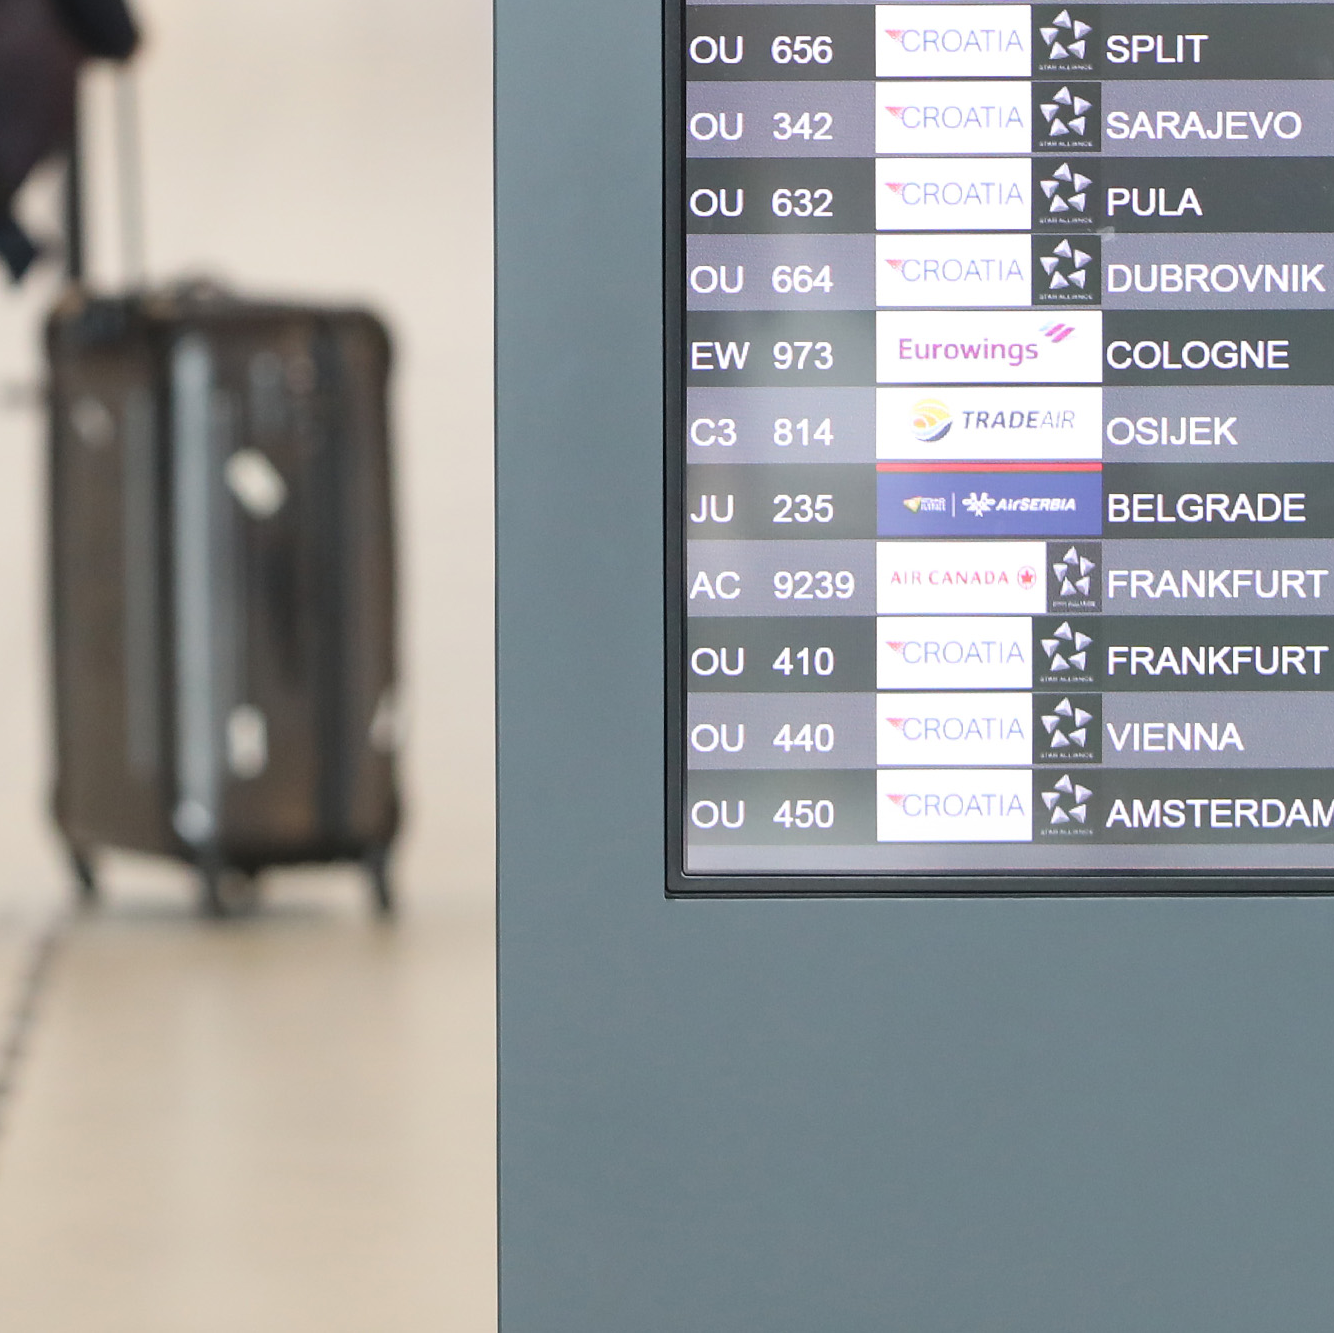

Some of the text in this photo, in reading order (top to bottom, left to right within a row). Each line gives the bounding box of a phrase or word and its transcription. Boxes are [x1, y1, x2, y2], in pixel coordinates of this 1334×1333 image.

[690, 112, 743, 141] OU
[772, 112, 833, 140] 342
[1106, 111, 1302, 140] SARAJEVO
[689, 188, 744, 217] OU
[772, 188, 833, 217] 632
[1107, 187, 1203, 216] PULA
[691, 341, 751, 370] EW
[773, 341, 834, 370] 973
[1106, 340, 1290, 370] COLOGNE
[899, 338, 1039, 367] Eurowings
[690, 418, 737, 447] C3
[773, 417, 834, 446] 814
[1106, 416, 1239, 446] OSIJEK
[690, 494, 734, 523] JU
[772, 494, 834, 523] 235
[1108, 493, 1306, 523] BELGRADE
[689, 571, 741, 600] AC
[773, 570, 855, 599] 9239
[1108, 569, 1329, 599] FRANKFURT
[890, 570, 1010, 585] AIR CANADA
[691, 647, 744, 676] OU
[772, 647, 834, 676] 410
[1108, 645, 1330, 675] FRANKFURT
[902, 641, 1025, 664] CROATIA
[691, 723, 744, 752] OU
[773, 723, 835, 752] 440
[1106, 722, 1245, 751] VIENNA
[691, 800, 745, 829] OU
[772, 799, 834, 828] 450
